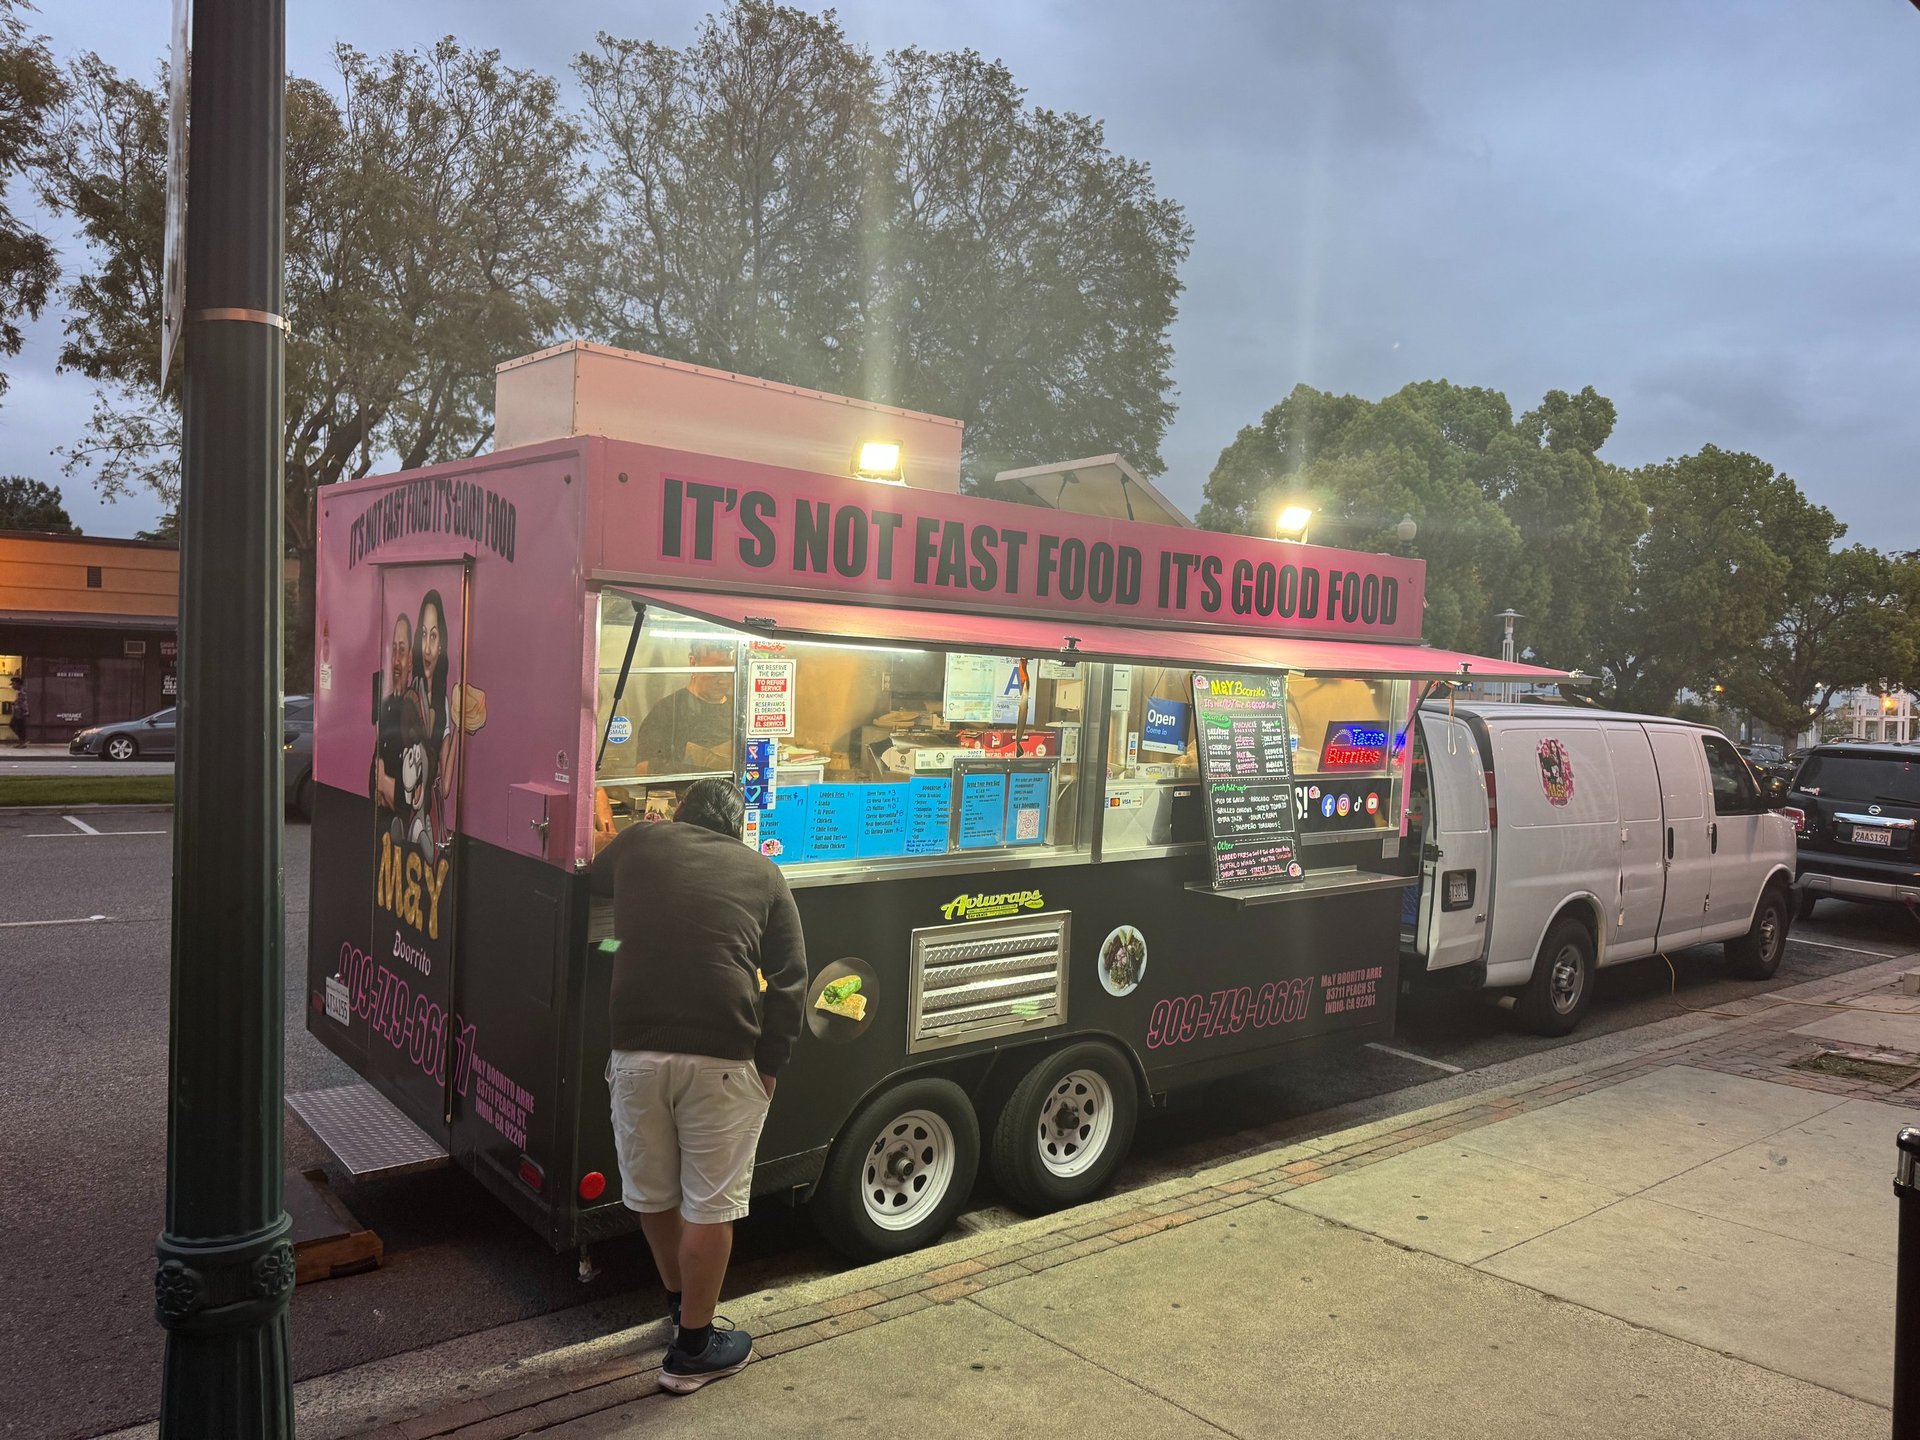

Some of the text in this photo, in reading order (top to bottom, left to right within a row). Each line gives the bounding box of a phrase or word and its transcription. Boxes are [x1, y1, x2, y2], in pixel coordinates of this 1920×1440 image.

[349, 478, 517, 570] IT'S NOT FAST FOOD IT'S GOOD FOOD
[662, 478, 1399, 625] IT'S NOT FAST FOOD IT'S GOOD FOOD
[1003, 666, 1024, 696] A
[1211, 679, 1234, 695] M&Y
[1147, 709, 1176, 726] Open
[1146, 726, 1161, 735] Come
[1353, 729, 1385, 746] Tacos
[986, 751, 1002, 759] wrap
[1327, 747, 1381, 765] Burritos
[377, 831, 449, 940] M&Y
[940, 889, 1043, 920] Aviwraps
[393, 930, 431, 976] Boorrito
[1321, 973, 1336, 988] M&Y
[1326, 986, 1345, 1001] 83711
[1346, 982, 1367, 998] PEACH
[1146, 976, 1314, 1049] 909-749-6661
[1346, 998, 1355, 1011] CA
[1356, 994, 1376, 1009] 92201
[472, 1053, 487, 1078] M&Y
[476, 1076, 495, 1105] 83711
[495, 1090, 517, 1122] PEACH
[495, 1111, 504, 1135] CA
[504, 1120, 527, 1152] 92201
